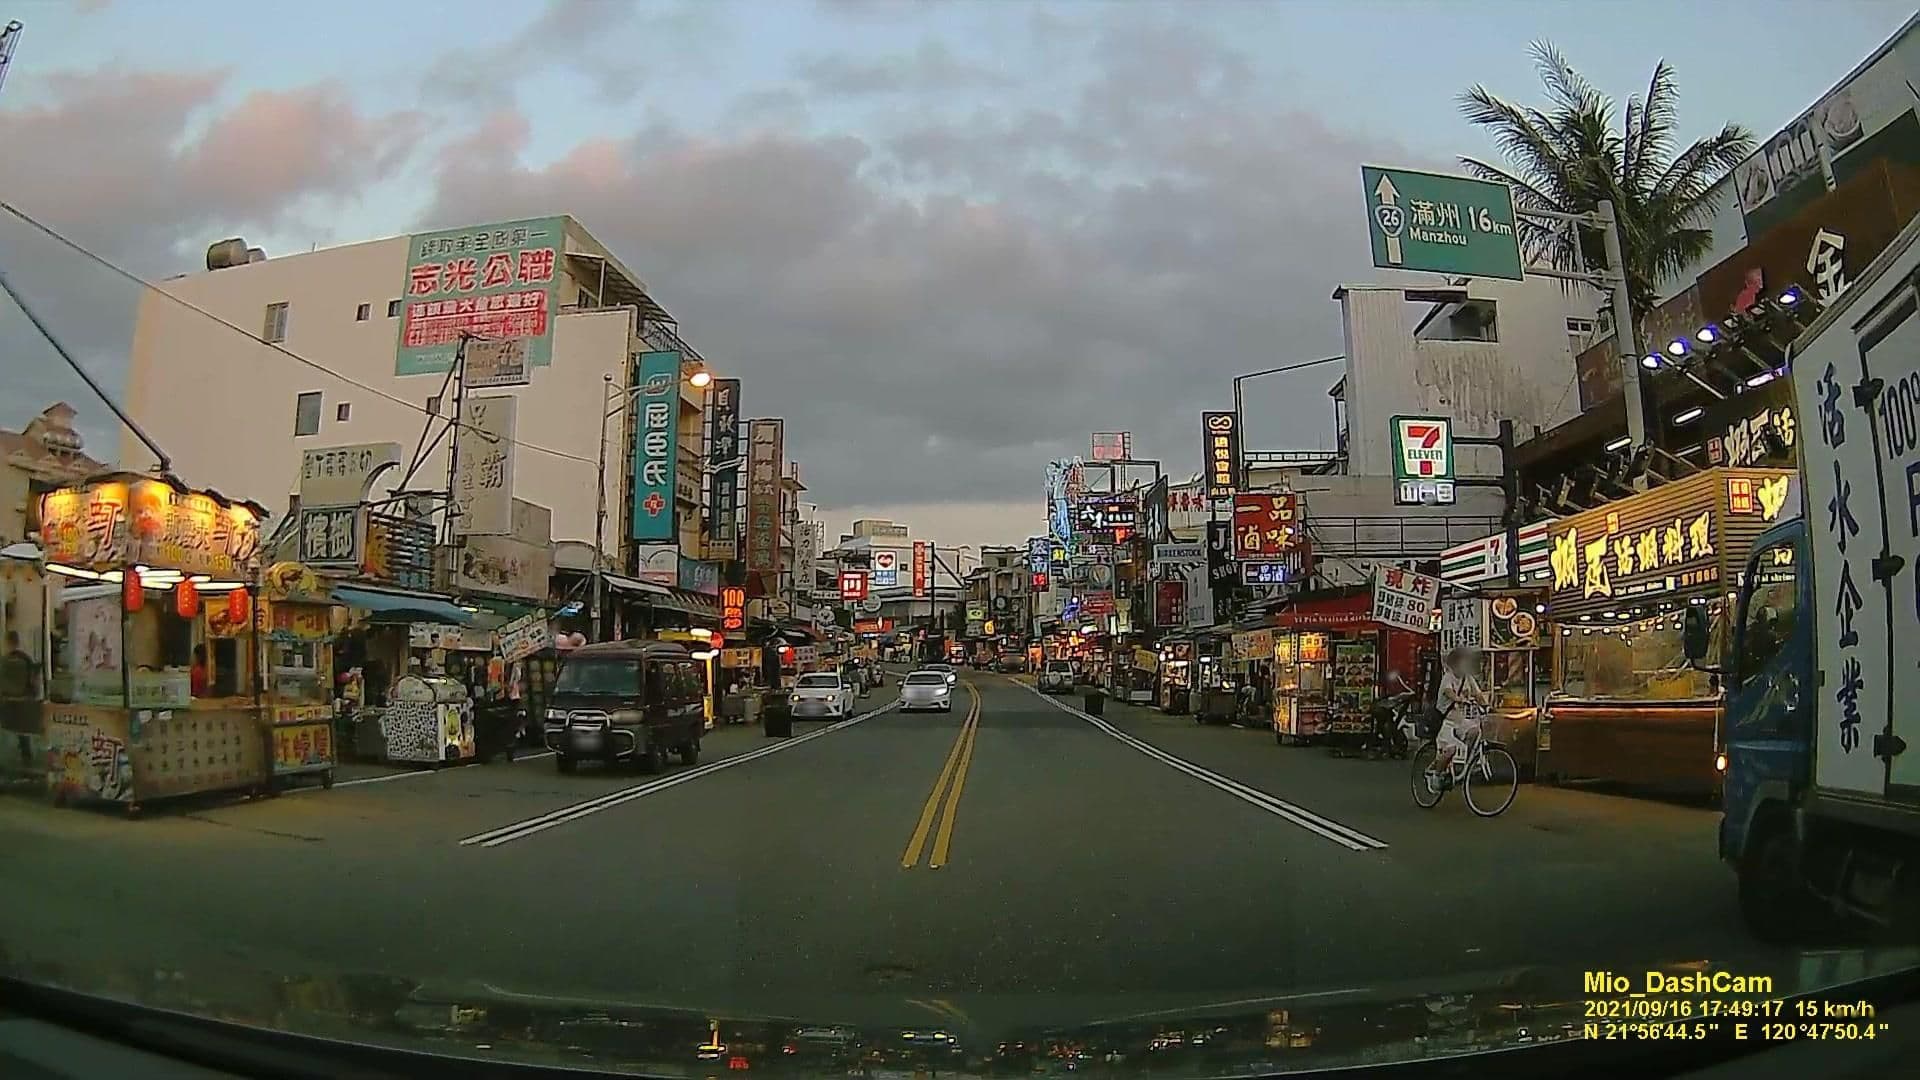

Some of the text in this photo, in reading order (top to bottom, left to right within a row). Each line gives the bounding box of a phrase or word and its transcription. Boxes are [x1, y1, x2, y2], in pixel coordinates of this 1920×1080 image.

[1381, 209, 1399, 227] 26
[1410, 200, 1461, 229] 滿州
[1409, 227, 1468, 246] Manzhou
[408, 249, 555, 295] 志光公職
[643, 402, 670, 487] 屈臣氏
[1235, 496, 1293, 521] 一品
[304, 510, 352, 558] 檳榔
[1816, 361, 1865, 754] 活水企業
[722, 588, 745, 608] 100
[1406, 599, 1425, 613] 80
[1404, 613, 1424, 628] 100
